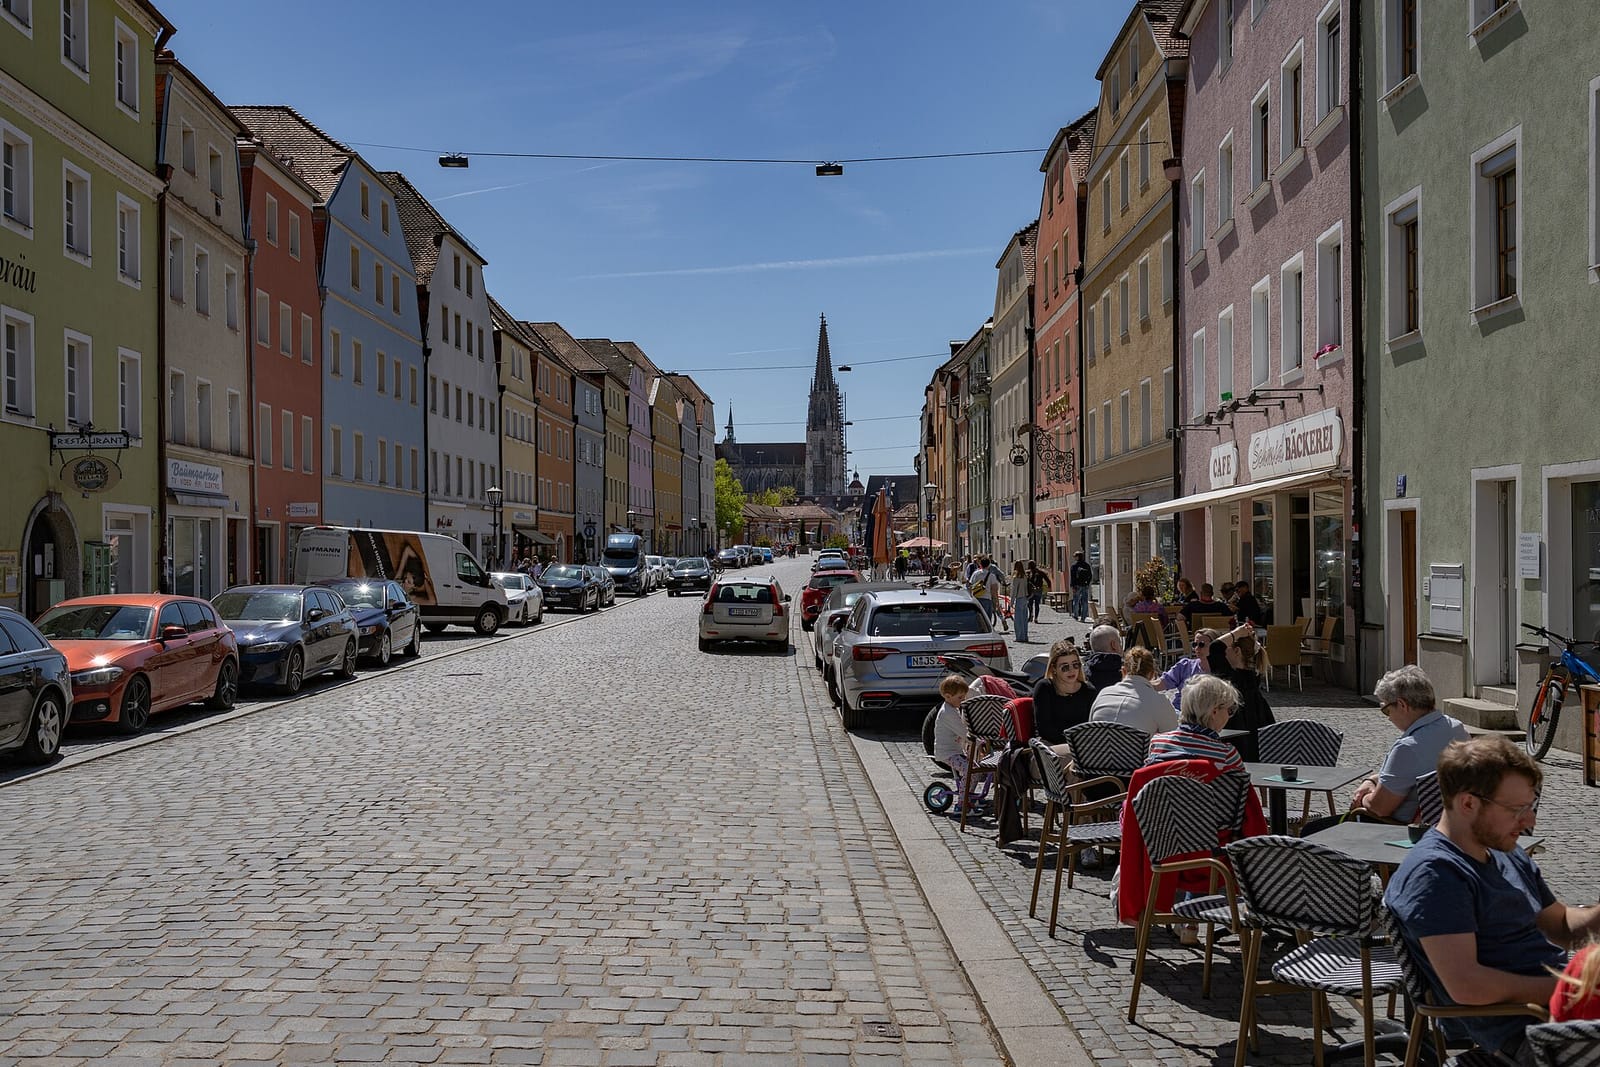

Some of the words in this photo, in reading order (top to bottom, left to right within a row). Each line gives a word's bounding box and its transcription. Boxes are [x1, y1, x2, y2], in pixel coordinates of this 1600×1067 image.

[57, 436, 123, 446] RESTAURANT
[1285, 425, 1334, 462] BÄCKEREI
[1213, 454, 1232, 478] CAFE
[912, 656, 919, 666] N
